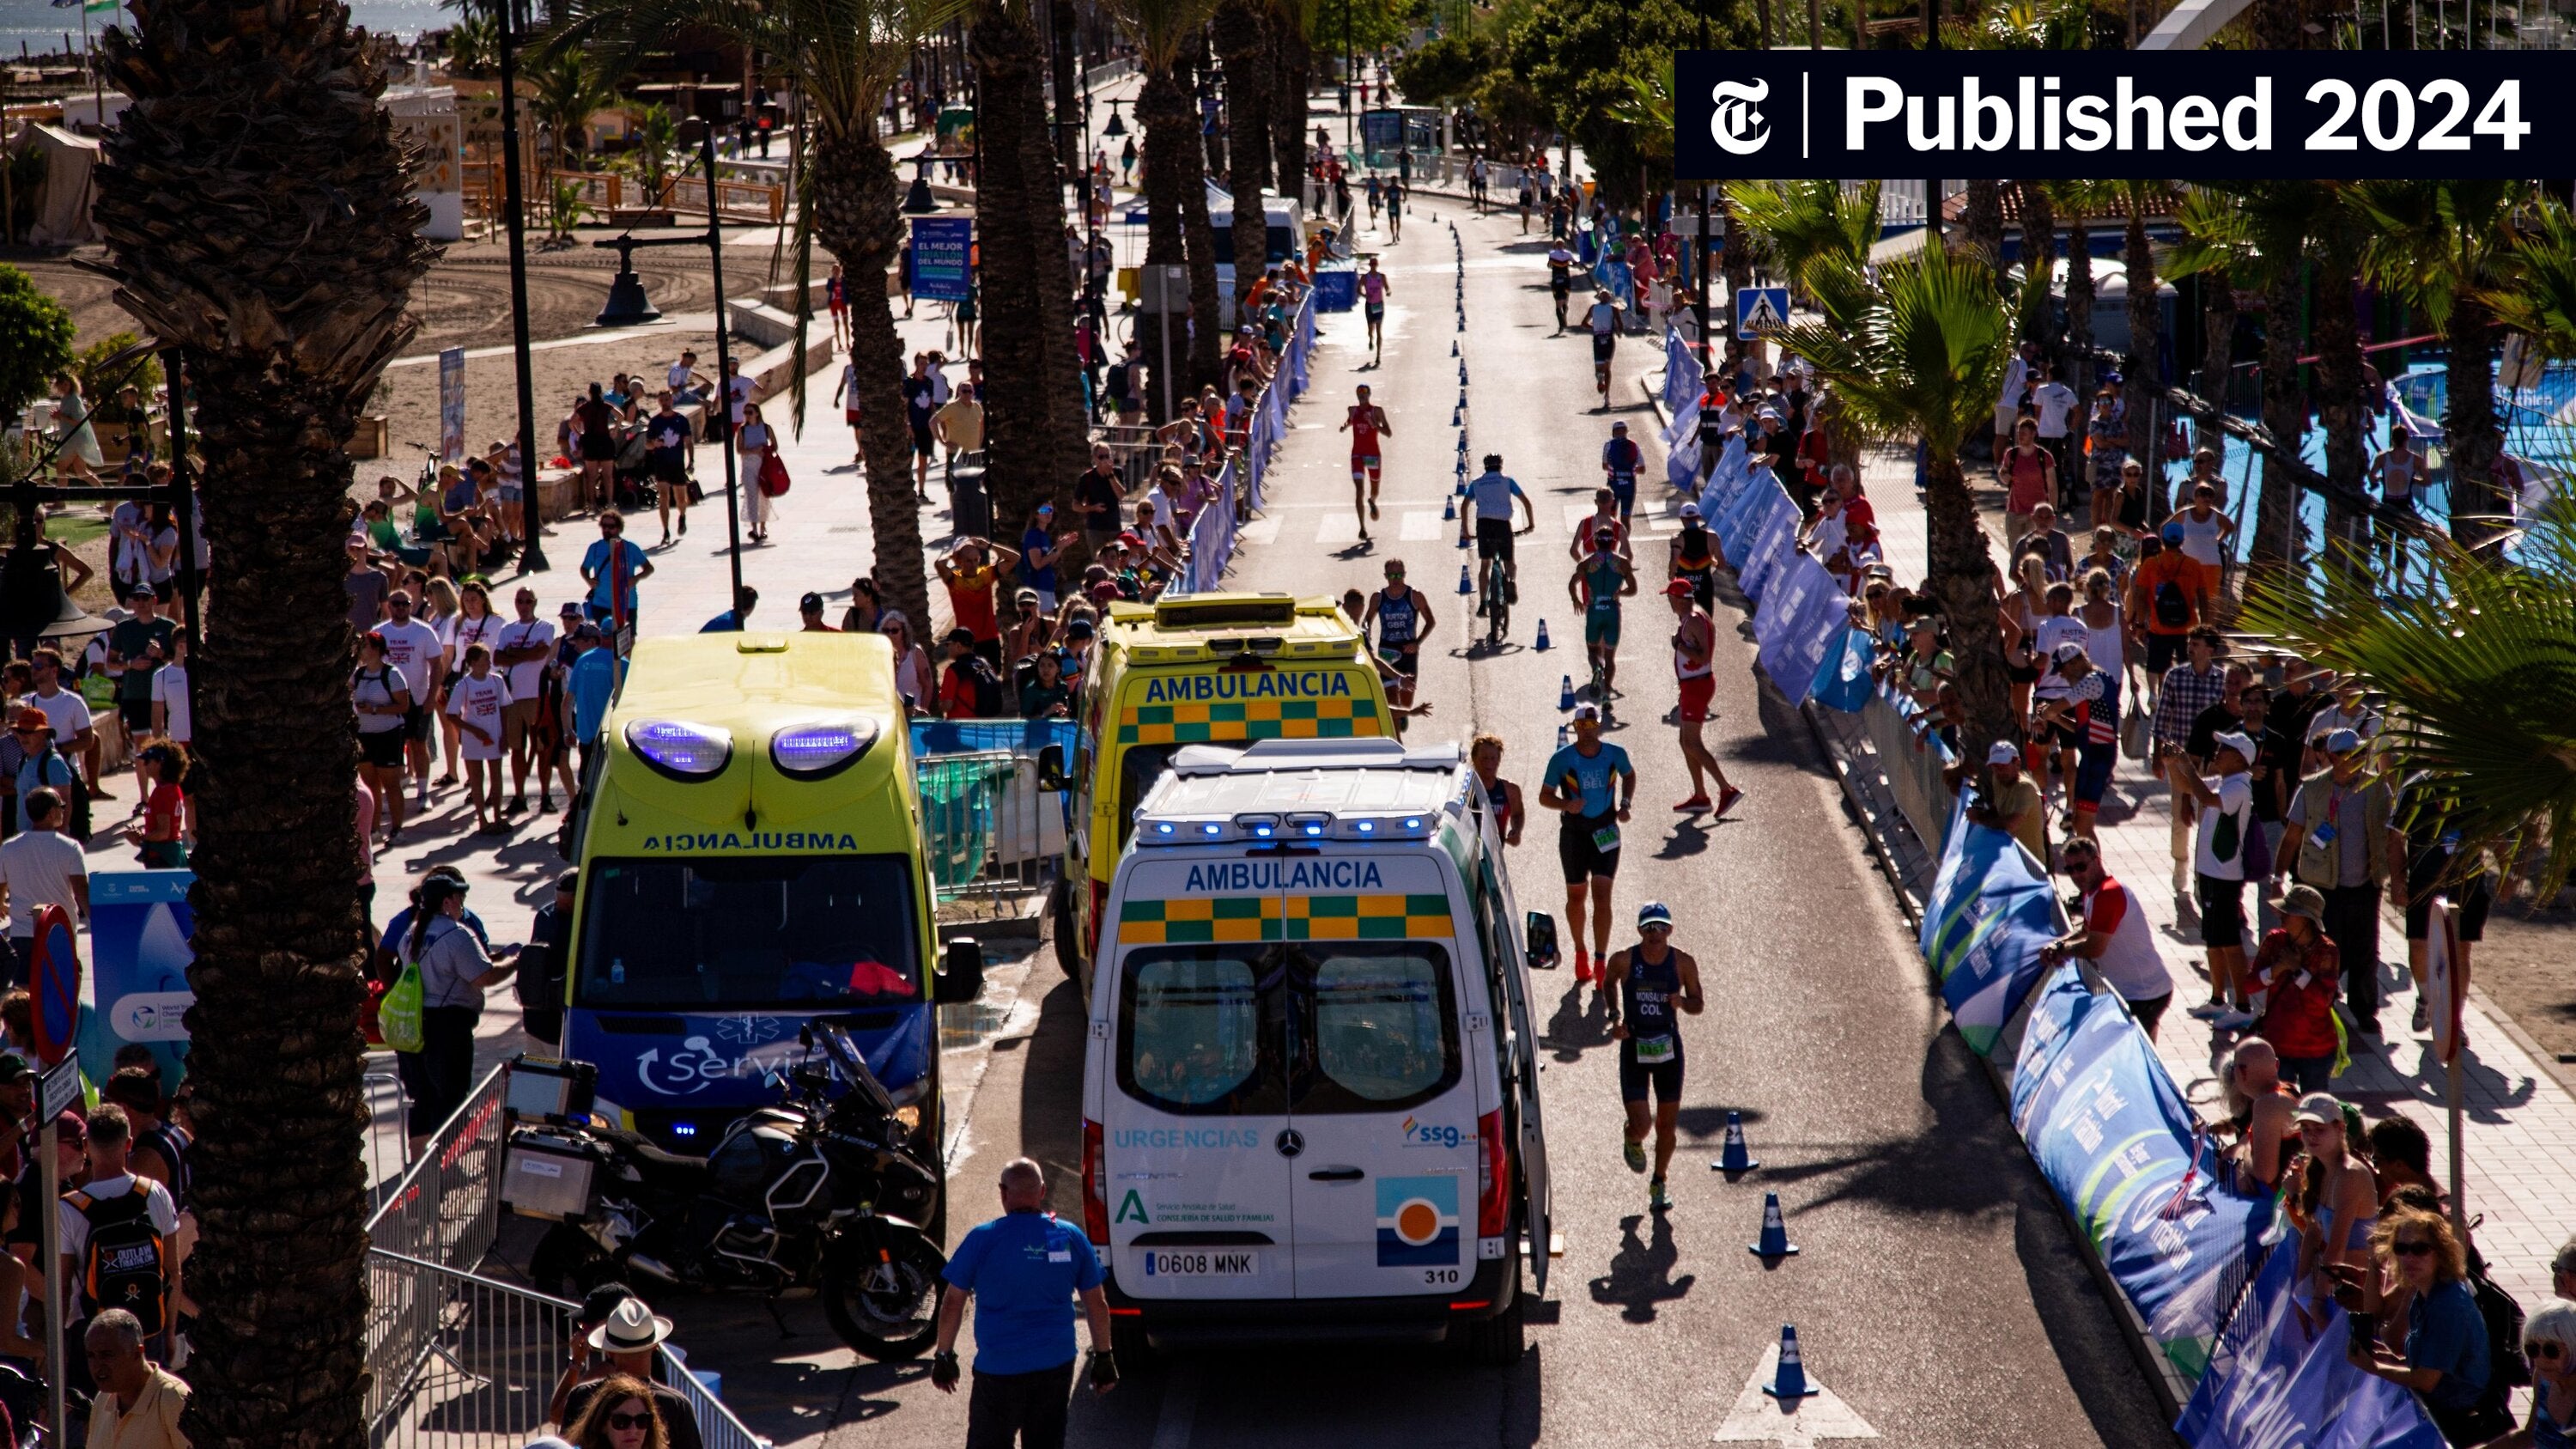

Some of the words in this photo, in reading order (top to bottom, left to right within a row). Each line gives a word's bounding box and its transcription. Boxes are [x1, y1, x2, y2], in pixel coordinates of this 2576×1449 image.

[931, 242, 963, 251] MEJOR
[1145, 673, 1351, 703] AMBULANCIA
[1583, 779, 1604, 789] BEL
[1185, 861, 1383, 892] AMBULANCIA
[1640, 1003, 1662, 1015] COL
[1115, 1129, 1259, 1149] URGENCIAS
[1420, 1126, 1459, 1148] ssg
[118, 1244, 152, 1260] OUTLAW
[1158, 1255, 1207, 1273] 0608
[1215, 1255, 1251, 1274] MNK
[1425, 1270, 1459, 1283] 310
